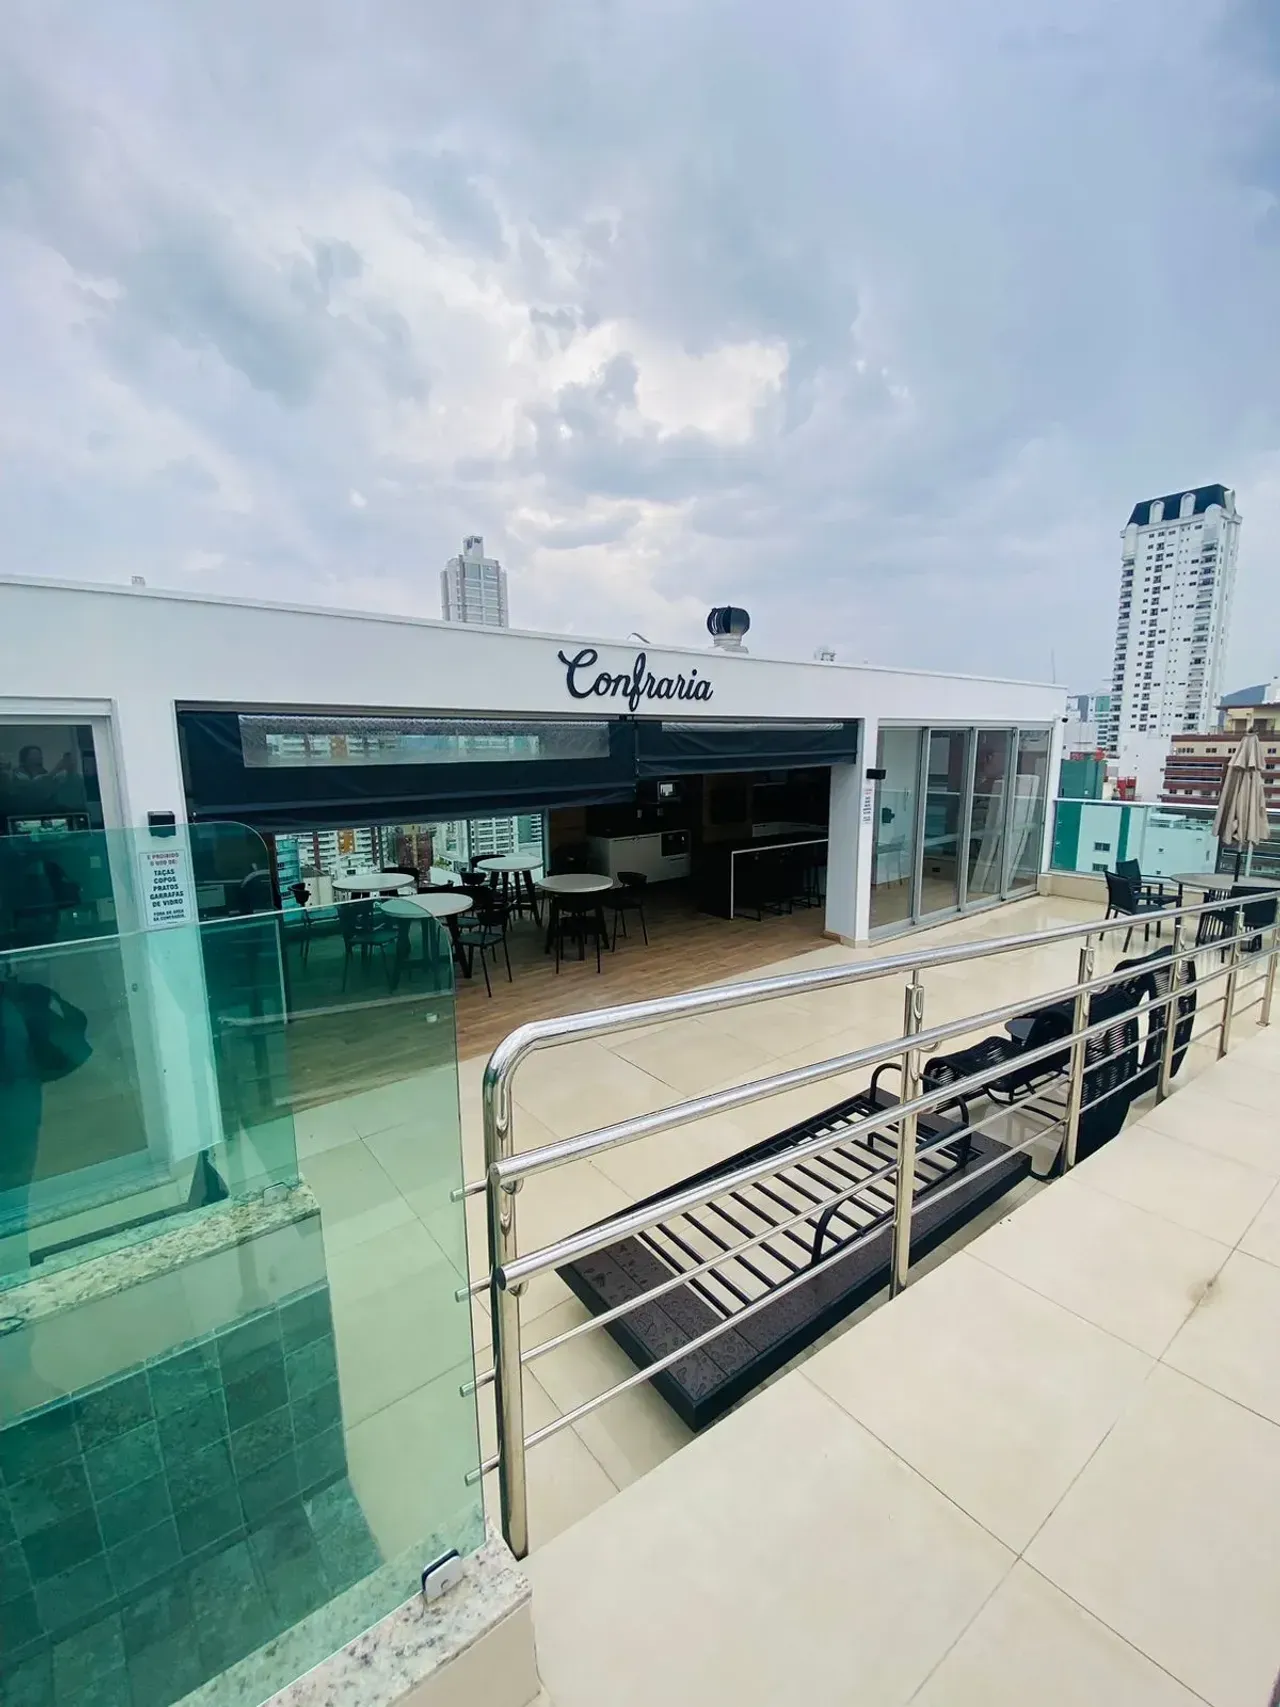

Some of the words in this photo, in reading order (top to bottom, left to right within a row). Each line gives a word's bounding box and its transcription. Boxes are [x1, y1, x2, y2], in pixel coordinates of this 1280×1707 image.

[558, 649, 713, 712] Confraria
[154, 868, 175, 877] TAÇAS
[153, 876, 177, 884] COPOS
[153, 884, 179, 892] PRATOS
[150, 891, 184, 900] GARRAFAS
[152, 900, 161, 908] DE
